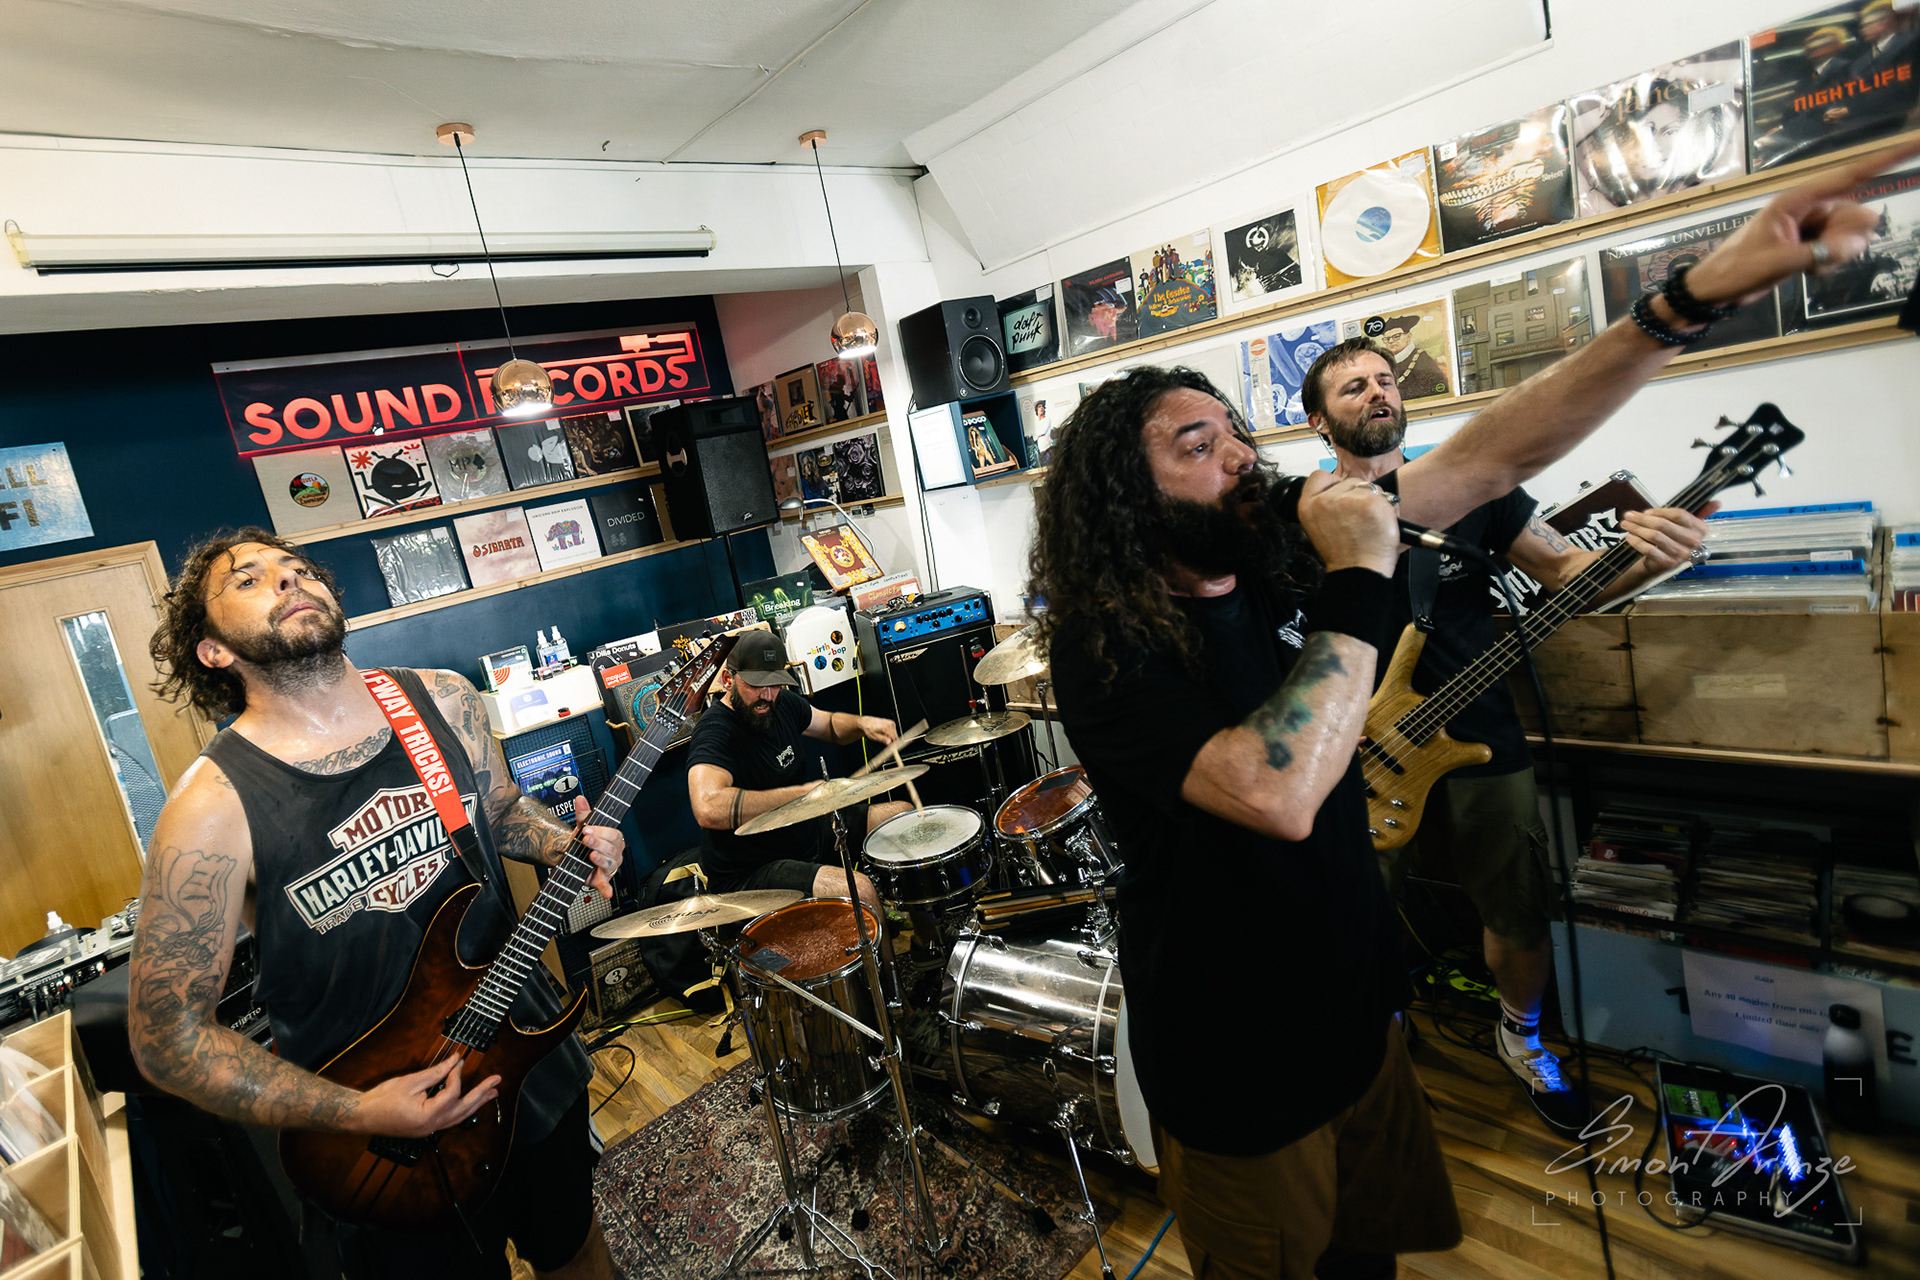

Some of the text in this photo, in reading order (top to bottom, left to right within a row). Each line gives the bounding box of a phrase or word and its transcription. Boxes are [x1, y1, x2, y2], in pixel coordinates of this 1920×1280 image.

[1014, 311, 1044, 330] daft
[1012, 322, 1044, 350] punk
[244, 354, 692, 446] SOUND CORDS
[0, 464, 48, 489] LL
[606, 511, 646, 528] DIVIDED
[763, 598, 801, 614] Breaking
[596, 649, 612, 658] Dilla
[612, 643, 637, 653] Donuts
[811, 642, 831, 655] birth
[831, 646, 847, 655] bop
[690, 663, 718, 694] Ibanez
[359, 670, 417, 720] LFWAY
[399, 721, 454, 798] TRICKS!
[516, 748, 563, 769] ELECTRONIC SOUND
[562, 777, 572, 792] 1
[343, 791, 431, 846] MOTOR
[372, 858, 439, 905] CYCLES
[315, 898, 365, 935] TRADE
[612, 970, 621, 984] 3
[1704, 989, 1722, 1000] Any
[1735, 1012, 1772, 1024] Limited
